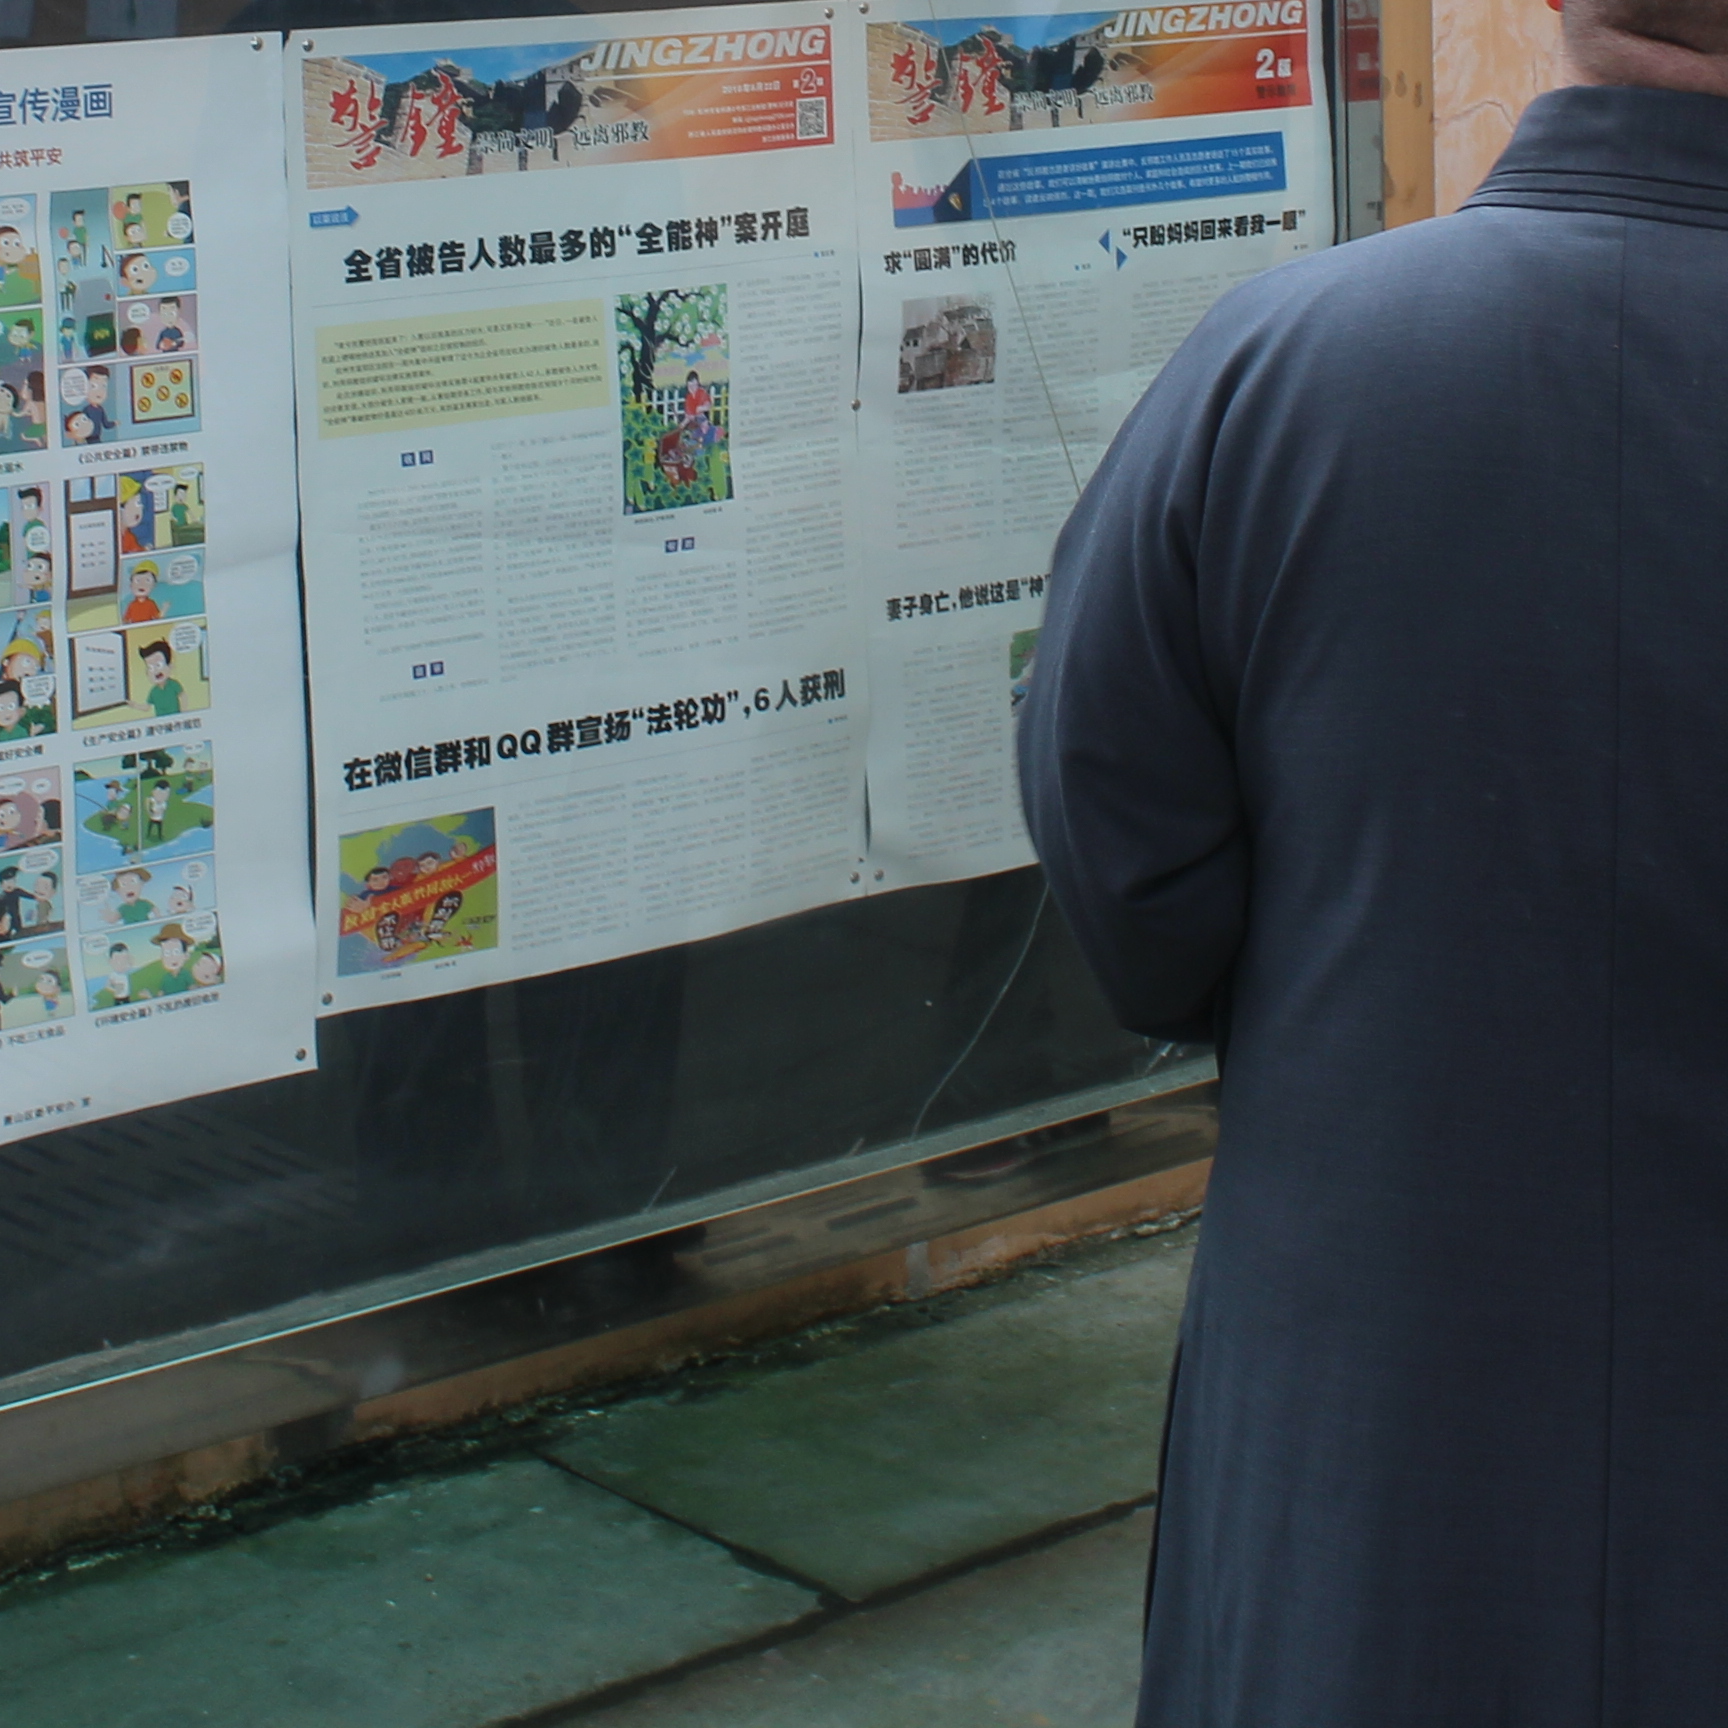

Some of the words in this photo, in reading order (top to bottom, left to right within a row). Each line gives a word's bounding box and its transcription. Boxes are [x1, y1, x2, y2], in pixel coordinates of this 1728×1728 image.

[580, 25, 827, 72] JINGZHONG
[1092, 83, 1155, 107] 远离邪教
[476, 126, 555, 155] 崇尚文明
[573, 121, 650, 148] 远离邪教
[343, 206, 811, 285] 全省被告人数最多的“全能神”案开庭
[883, 240, 1018, 274] 求“圆满”的代价
